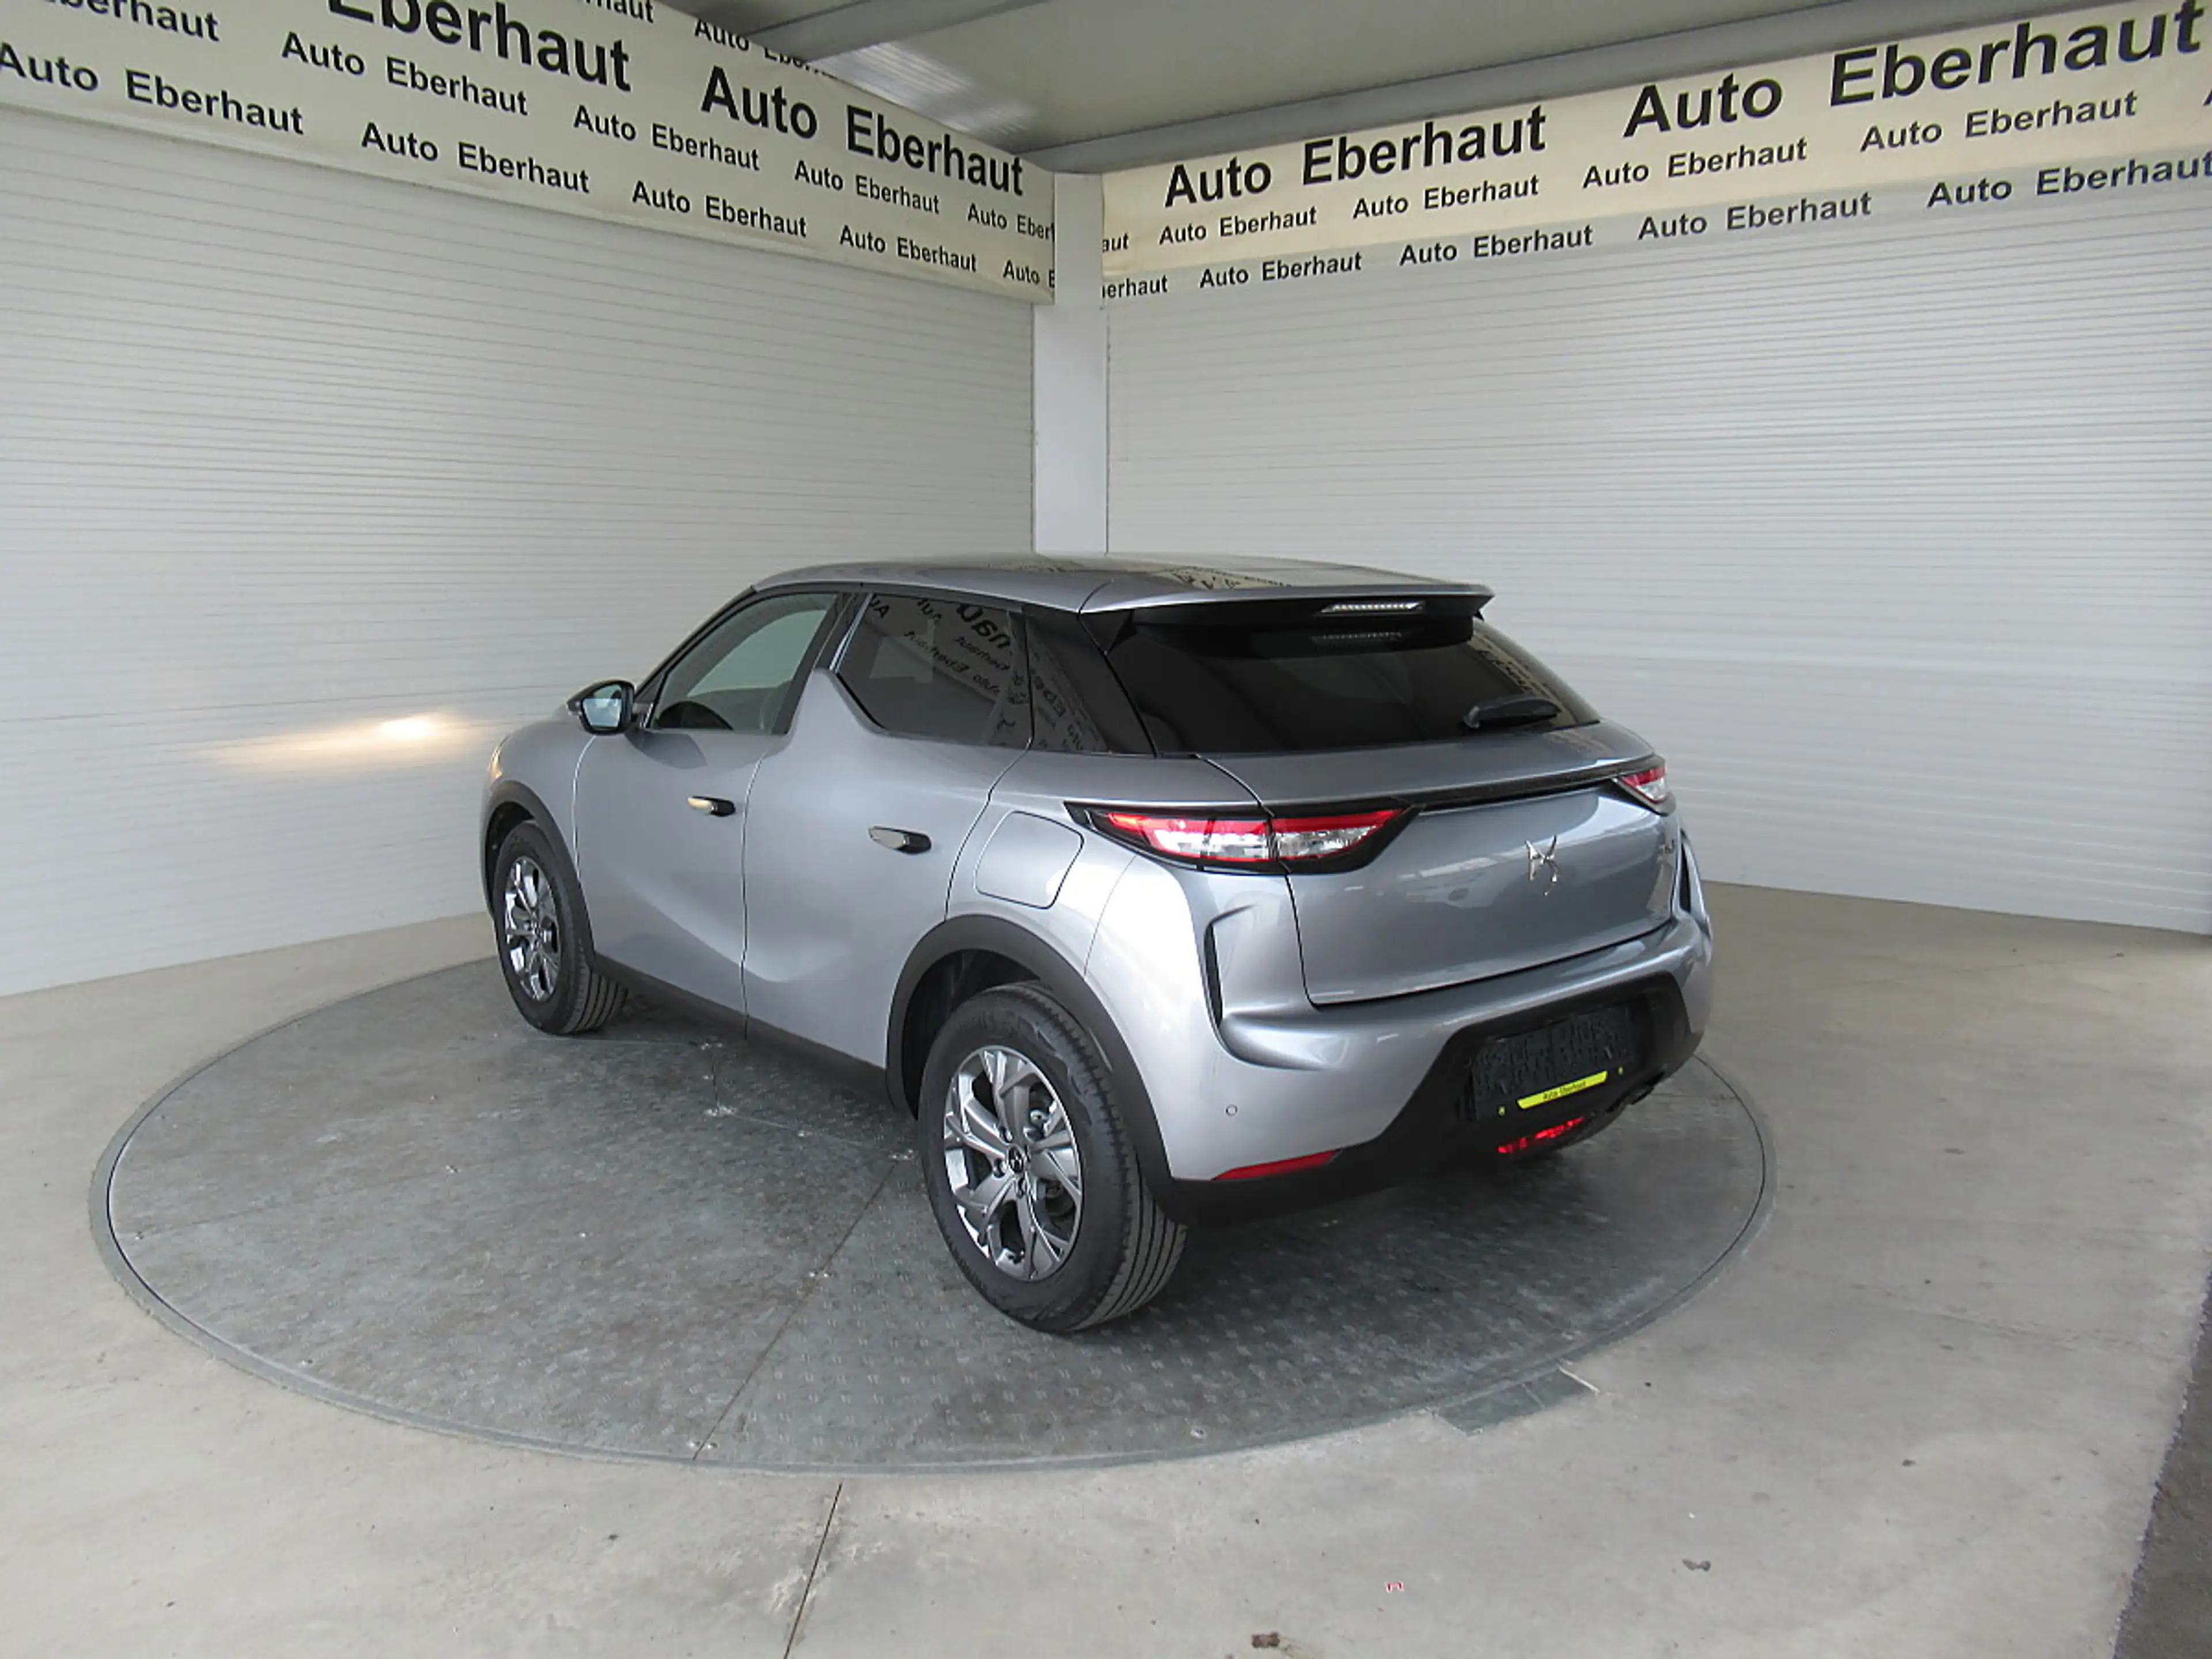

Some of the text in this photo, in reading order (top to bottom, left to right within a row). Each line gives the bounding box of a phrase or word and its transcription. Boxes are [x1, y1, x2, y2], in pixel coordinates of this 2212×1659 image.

[0, 41, 305, 135] Auto Eberhaut
[281, 31, 528, 116] Auto Eberhaut
[1623, 0, 2204, 138] Auto Eberhaut
[573, 105, 760, 171] Auto Eberhaut
[700, 65, 818, 139] Auto
[846, 104, 1024, 196] Eberhaut
[1860, 90, 2138, 151] Auto Eberhaut
[361, 122, 590, 194] Auto Eberhaut
[1165, 104, 1546, 207] Auto Eberhaut
[1582, 138, 1807, 189] Auto Eberhaut
[632, 180, 806, 238] Auto Eberhaut
[794, 159, 940, 215] Auto Eberhaut
[1352, 175, 1539, 220] Auto Eberhaut
[1927, 177, 2013, 208] Auto
[967, 202, 1009, 230] Auto
[1159, 224, 1207, 245] Auto
[1219, 207, 1317, 237] Eberhaut
[1638, 192, 1872, 240] Auto Eberhaut
[839, 225, 978, 273] Auto Eberhaut
[1200, 252, 1362, 289] Auto Eberhaut
[1400, 225, 1593, 266] Auto Eberhaut
[1002, 259, 1041, 286] Auto
